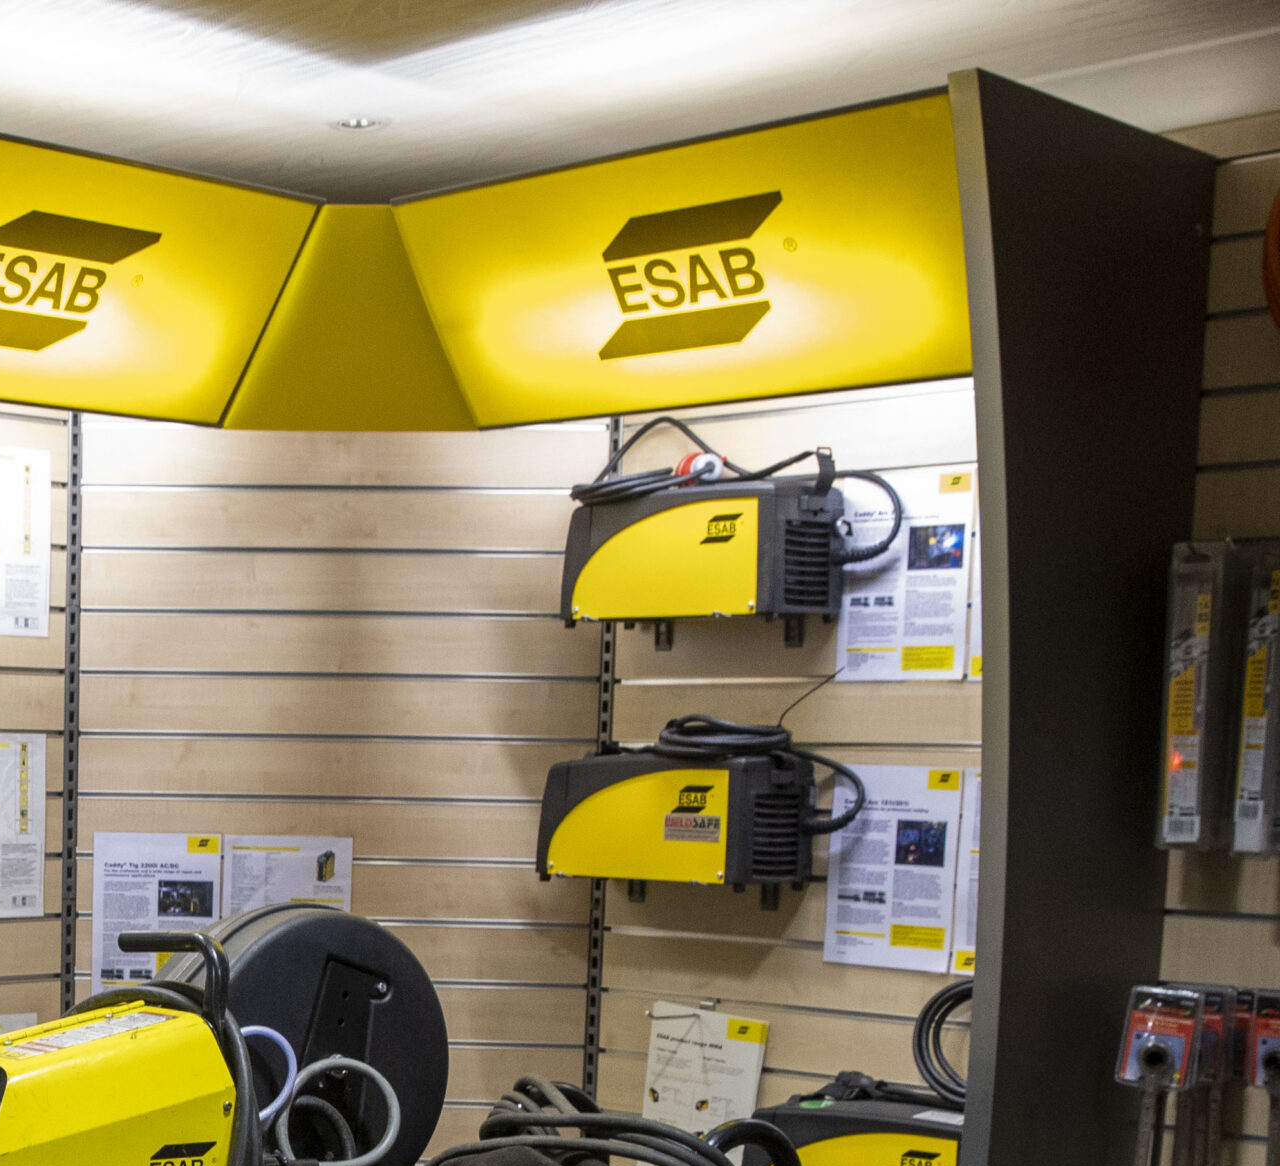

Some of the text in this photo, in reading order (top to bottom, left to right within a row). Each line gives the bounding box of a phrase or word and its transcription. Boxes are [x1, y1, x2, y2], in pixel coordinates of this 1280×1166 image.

[607, 247, 767, 314] ESAB
[706, 522, 737, 535] ESAB
[678, 792, 707, 805] ESAB
